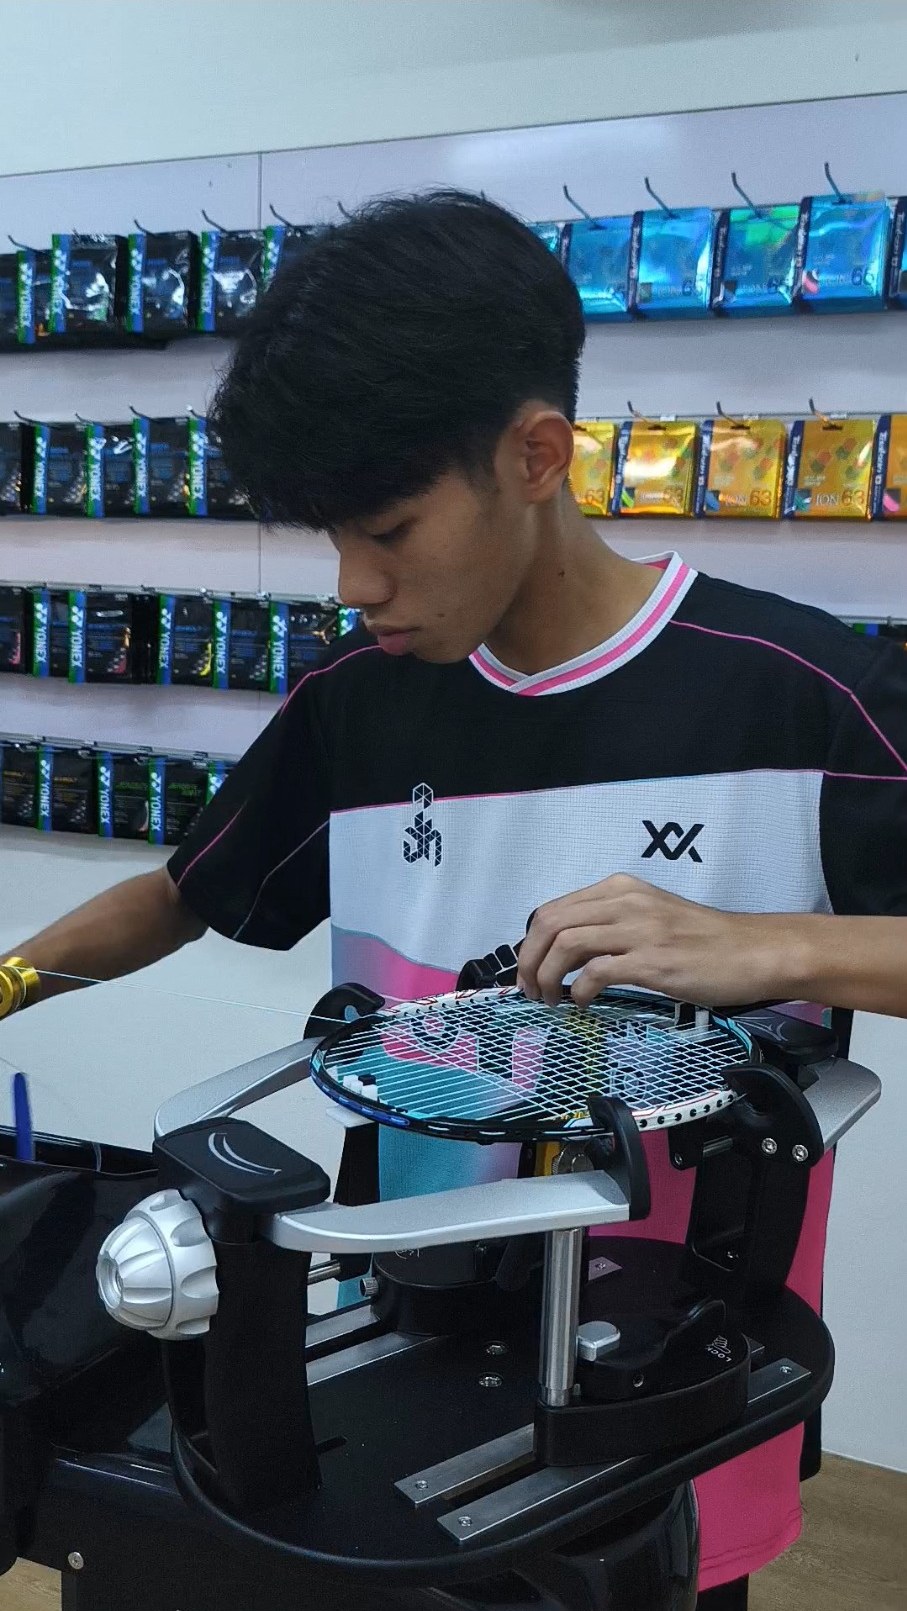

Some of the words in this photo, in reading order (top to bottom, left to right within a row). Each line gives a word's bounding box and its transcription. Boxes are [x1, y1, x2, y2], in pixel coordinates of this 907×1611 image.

[19, 289, 32, 327] YONEX
[128, 275, 141, 315] YONEX
[35, 461, 45, 497] YONEX
[89, 463, 101, 501] YONEX
[135, 458, 147, 497] YONEX
[191, 460, 204, 499] YONEX
[750, 489, 771, 506] 63
[816, 494, 838, 505] ION
[842, 489, 864, 506] 63
[34, 626, 47, 663] YONEX
[70, 631, 83, 668] YONEX
[159, 631, 172, 669] YONEX
[215, 635, 226, 674] YONEX
[272, 640, 285, 679] YONEX
[40, 783, 50, 817] YONEX
[99, 789, 111, 824] YONEX
[150, 795, 162, 831] YONEX
